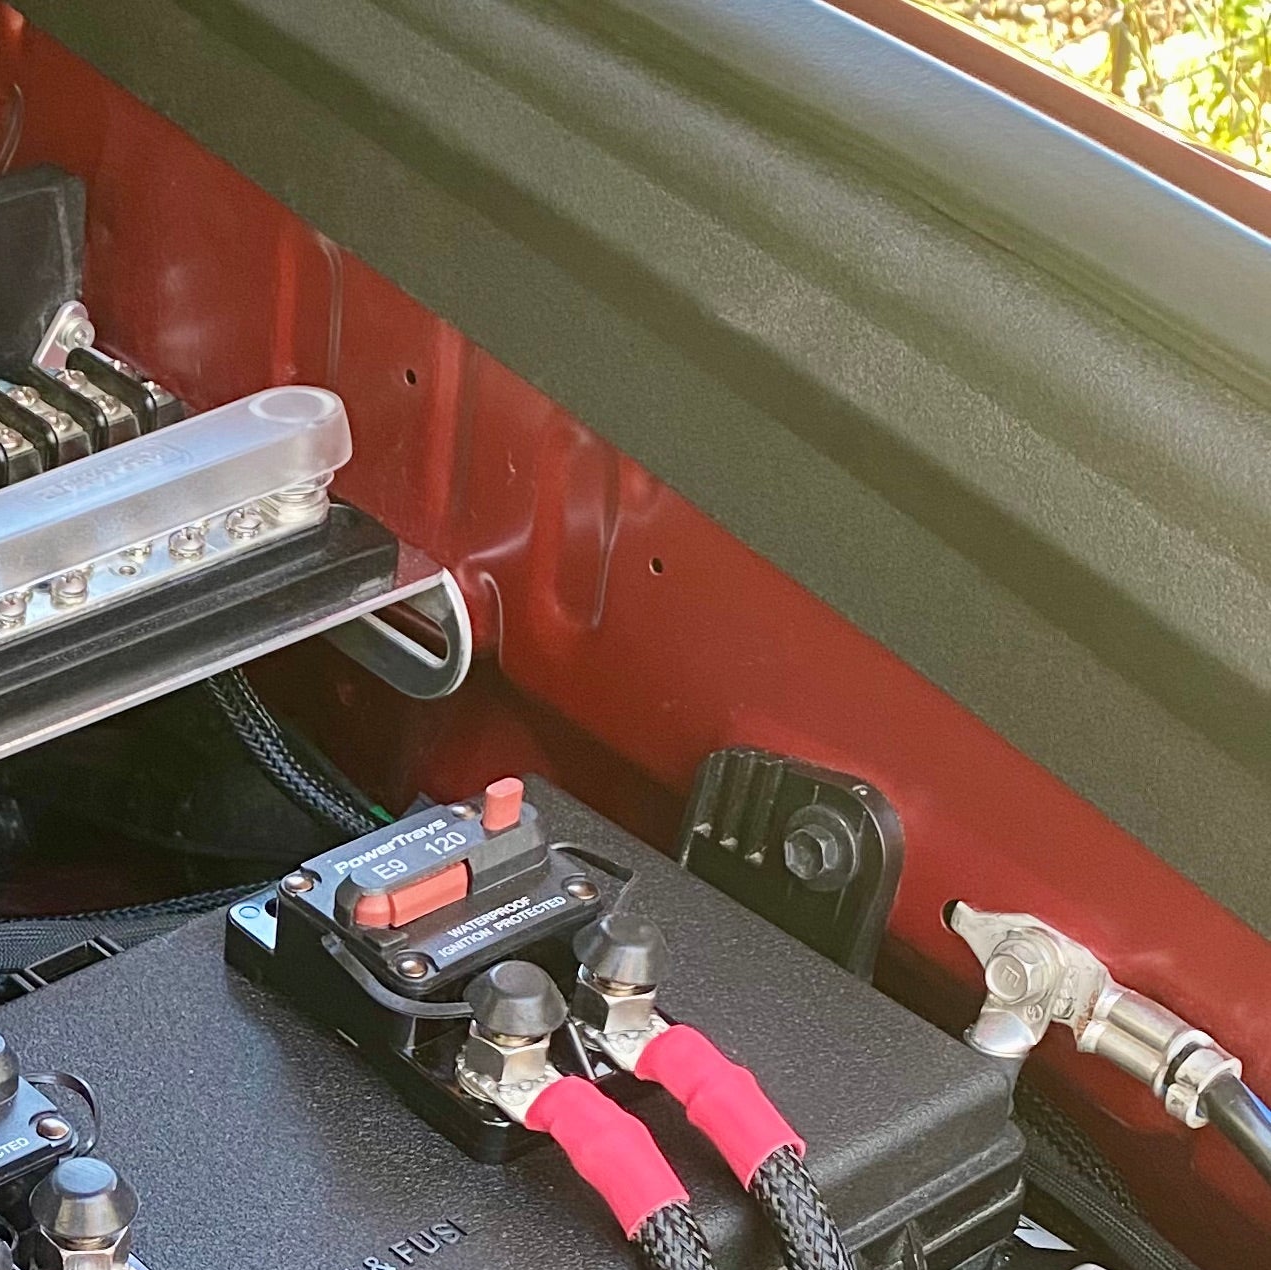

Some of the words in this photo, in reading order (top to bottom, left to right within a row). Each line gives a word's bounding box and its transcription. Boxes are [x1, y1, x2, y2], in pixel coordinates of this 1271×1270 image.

[333, 817, 449, 875] PowerTrays
[372, 858, 408, 881] E9
[423, 830, 467, 857] 120
[437, 926, 494, 958] IGNITION
[493, 895, 567, 931] PROTECTED
[446, 895, 532, 939] WATERPROOF
